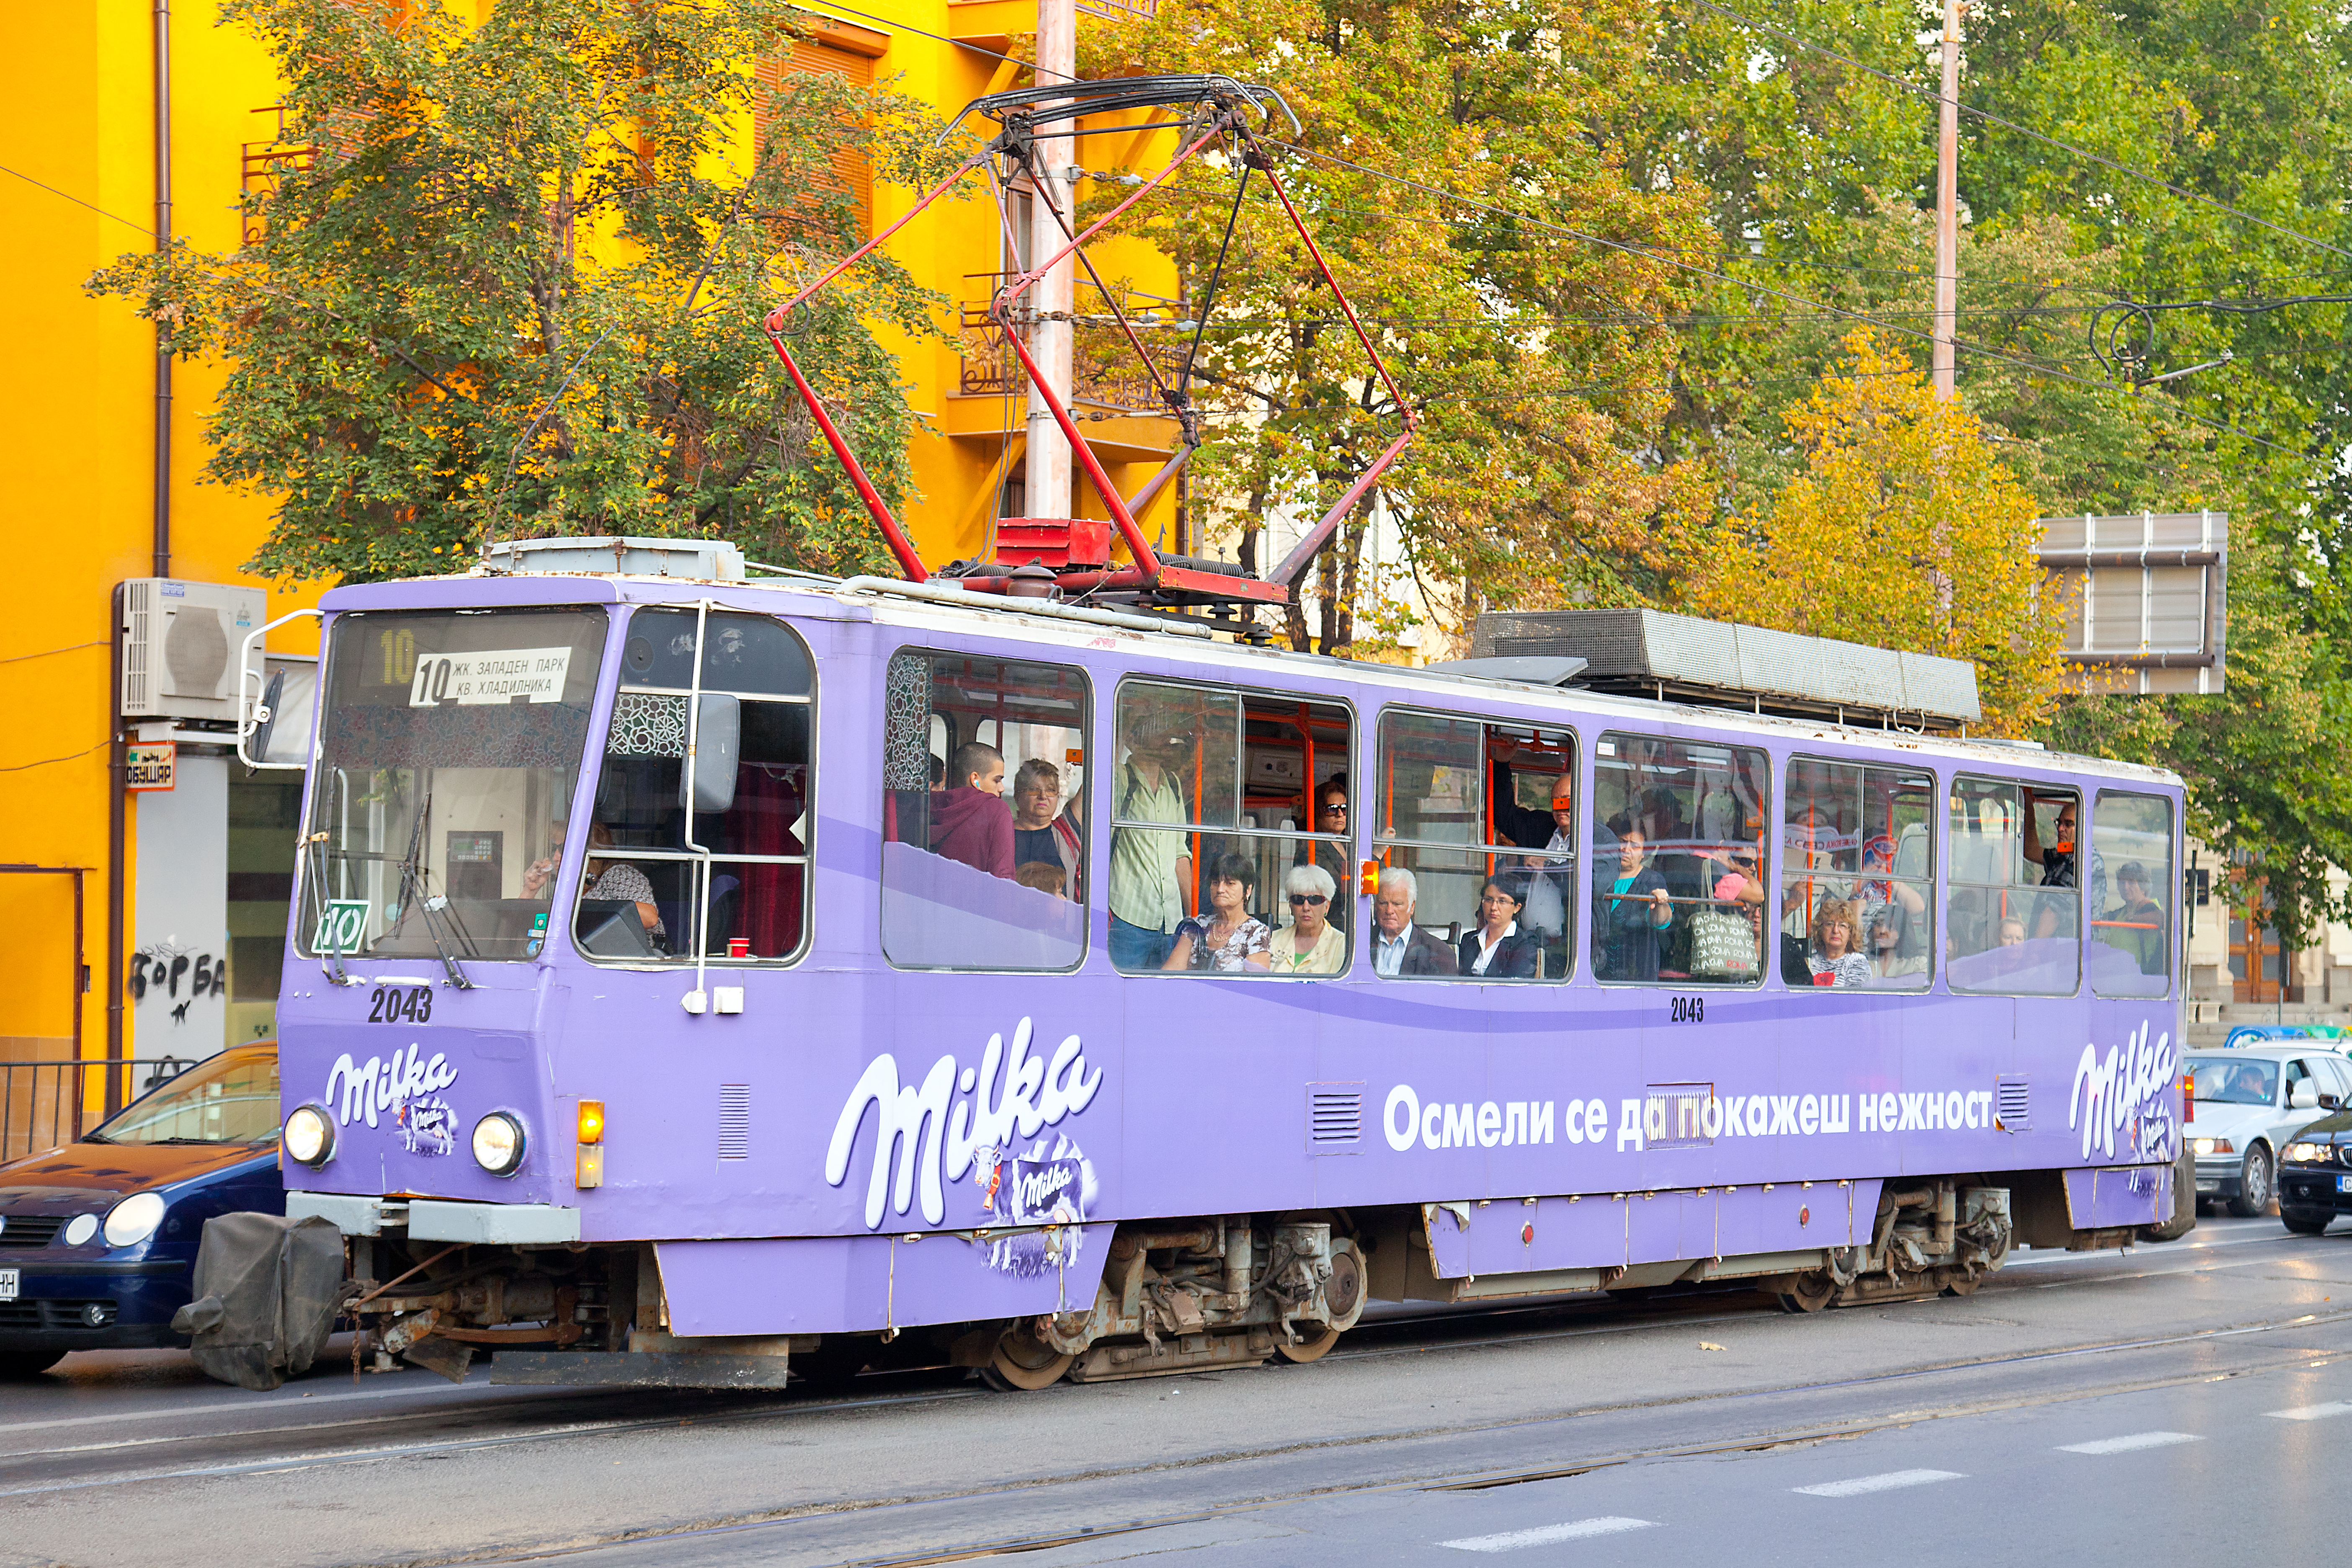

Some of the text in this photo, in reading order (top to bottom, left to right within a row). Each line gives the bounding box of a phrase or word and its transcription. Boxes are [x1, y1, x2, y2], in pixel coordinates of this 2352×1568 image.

[381, 629, 414, 683] 10
[452, 658, 565, 677] ЖК. ЗАПАДЕН ПАРК
[419, 658, 451, 703] 10
[456, 679, 552, 696] КВ. ХЛАДИЛНИКА
[322, 907, 361, 946] 10
[1726, 959, 1747, 970] ROMA
[368, 988, 433, 1023] 2043
[1671, 997, 1703, 1022] 2043
[325, 1043, 458, 1128] Milka
[2069, 1019, 2177, 1161] Milka
[415, 1109, 443, 1128] Milka
[825, 1016, 1102, 1230] Milka
[1383, 1085, 1554, 1151] Осмели
[1565, 1099, 1608, 1144] се
[1617, 1099, 1666, 1152] да
[1678, 1094, 1849, 1139] покажеш
[2146, 1119, 2166, 1149] Milka
[1020, 1164, 1072, 1208] Milka
